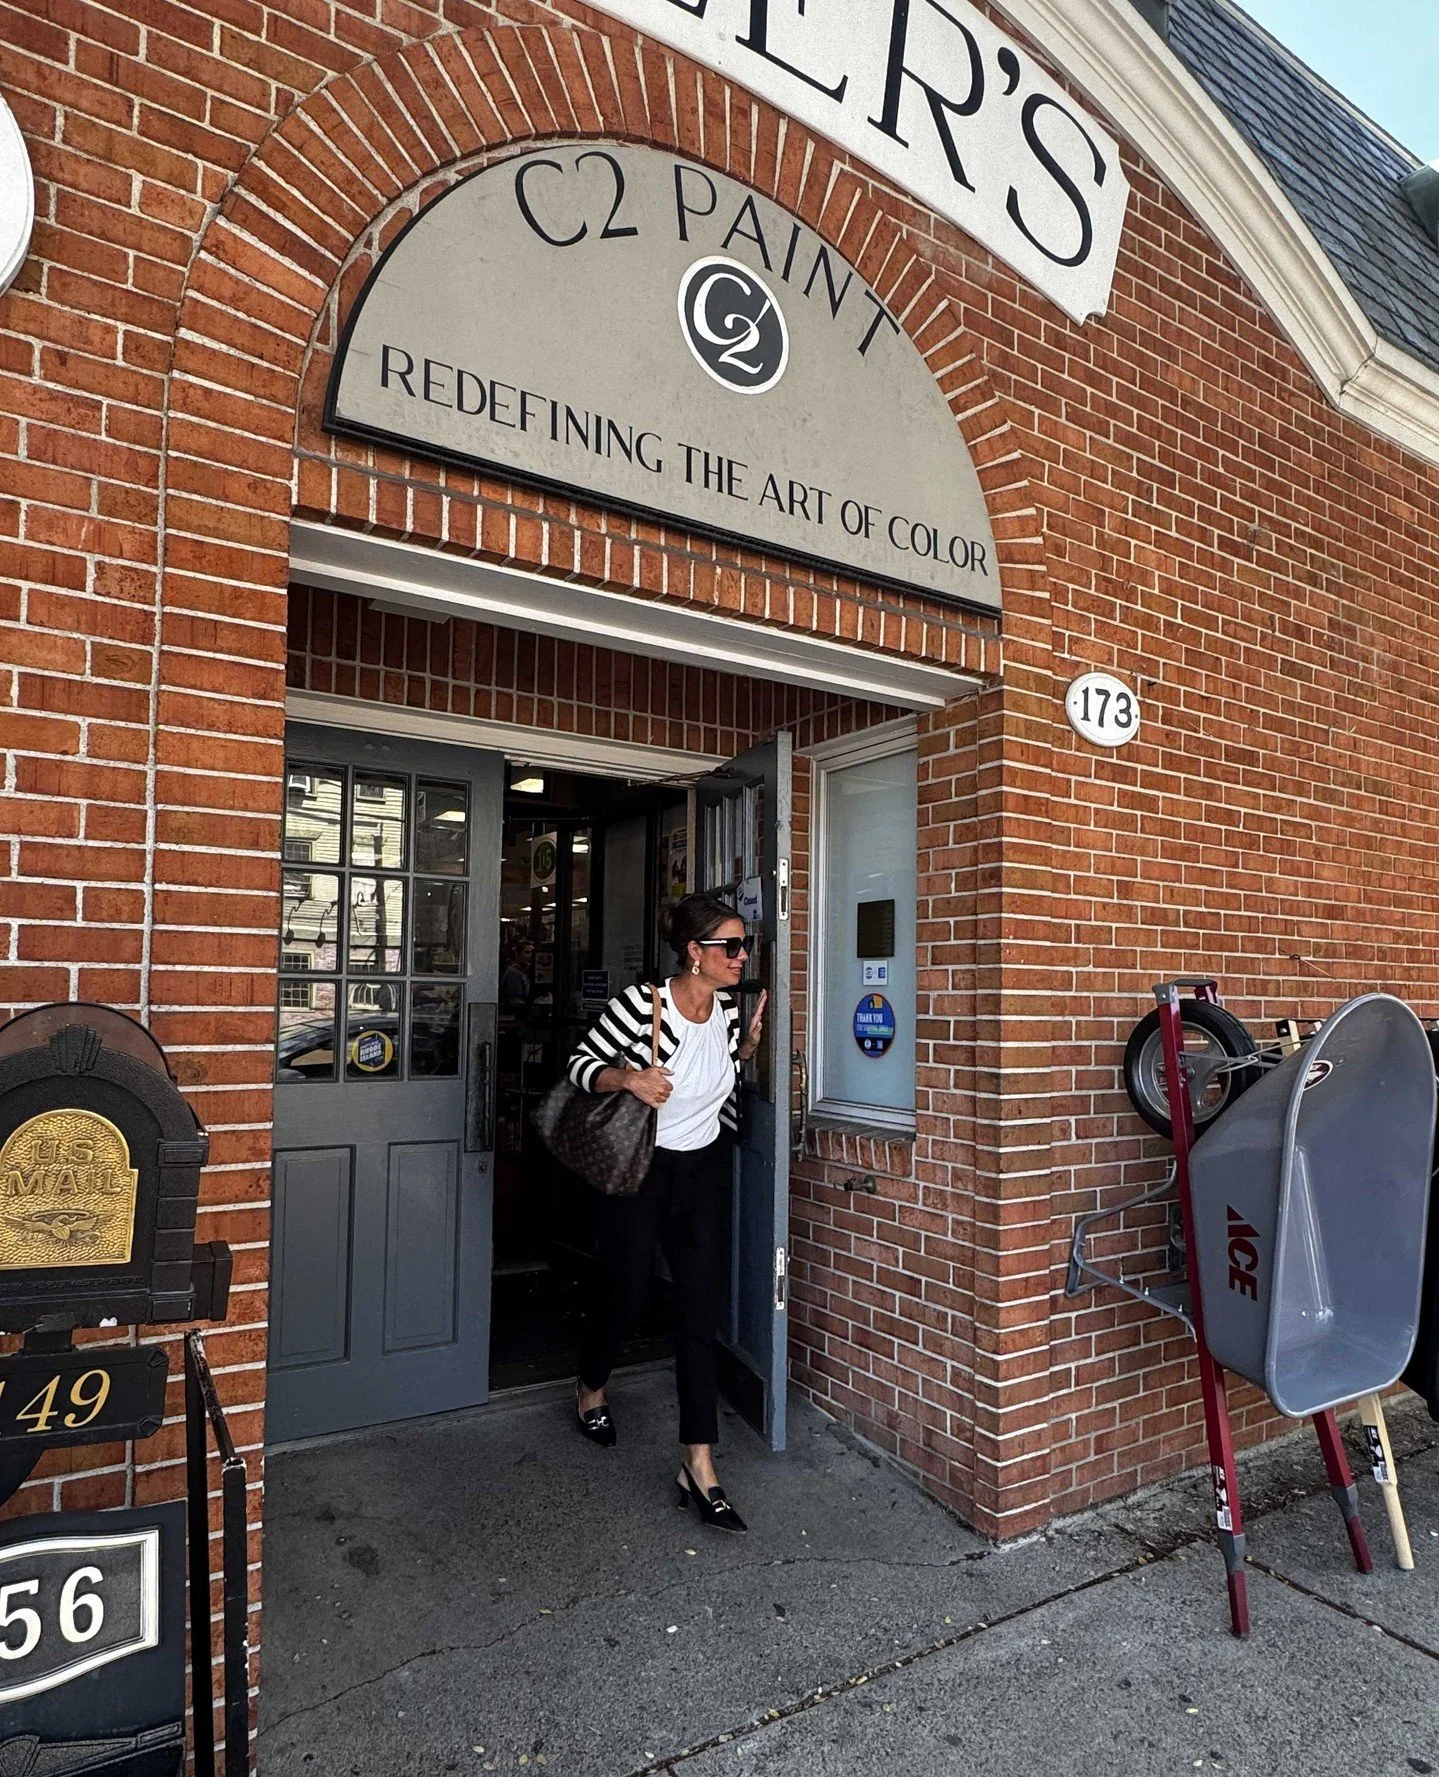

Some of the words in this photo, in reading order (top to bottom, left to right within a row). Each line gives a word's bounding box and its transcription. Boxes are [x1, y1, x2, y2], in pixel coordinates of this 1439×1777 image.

[667, 0, 1106, 267] ER'S
[515, 151, 638, 246] C2
[674, 164, 900, 358] PAINT
[381, 344, 663, 473] REDEFINING
[678, 443, 749, 500] THE
[758, 473, 832, 525] ART
[840, 500, 882, 539] OF
[888, 516, 989, 576] COLOR
[1080, 686, 1132, 729] 173
[6, 1168, 121, 1195] MAIL
[1226, 1204, 1261, 1302] ACE
[0, 1566, 104, 1660] 56
